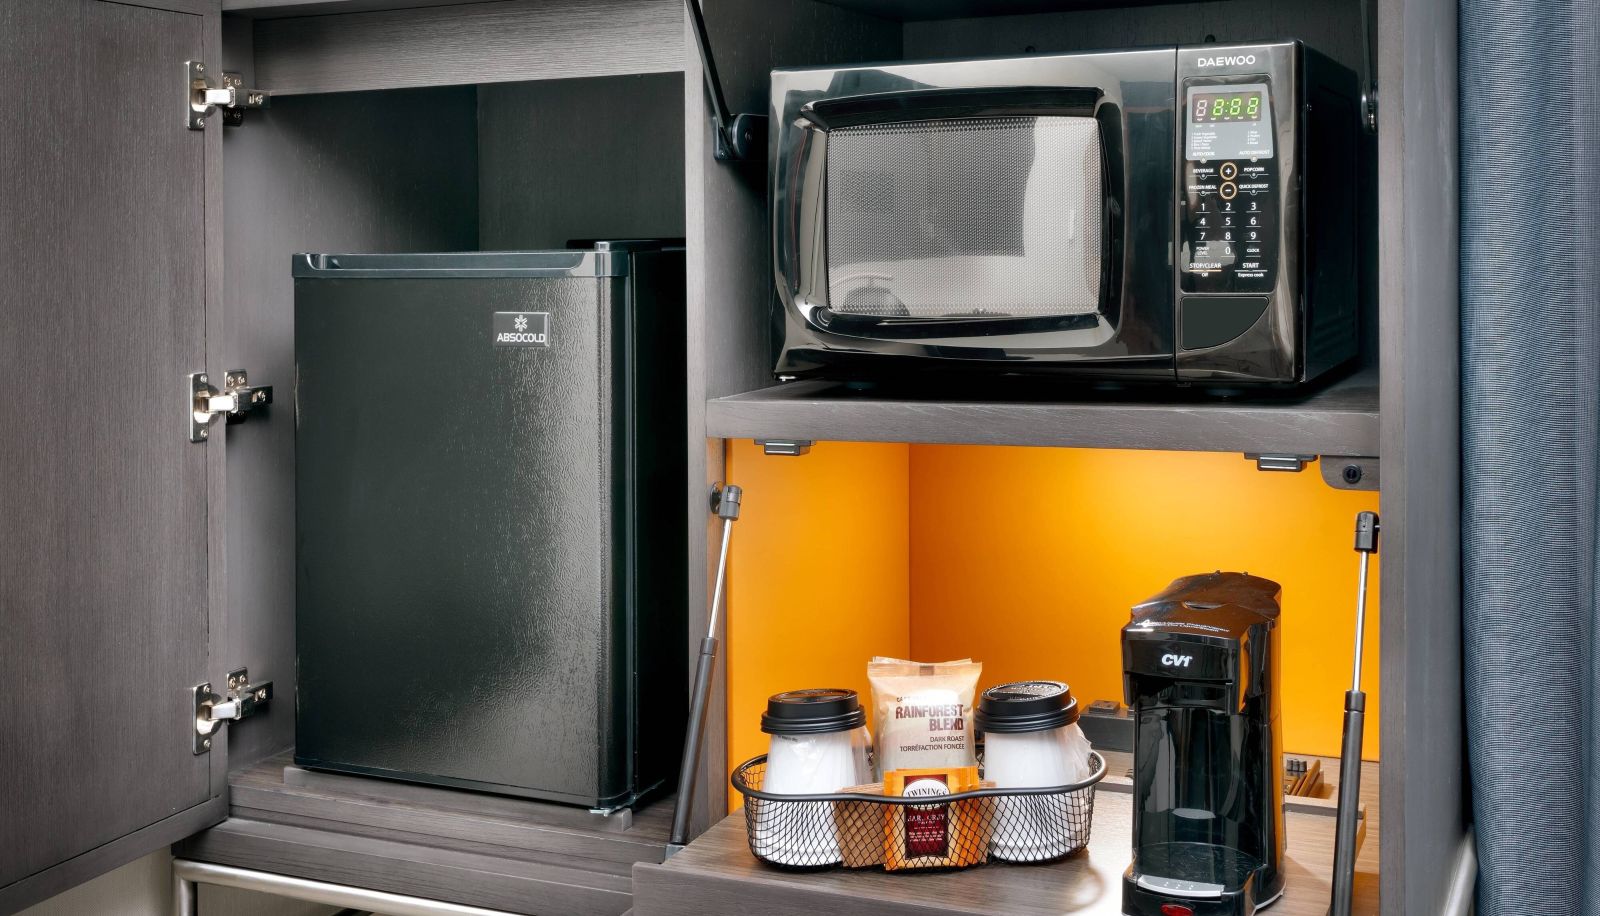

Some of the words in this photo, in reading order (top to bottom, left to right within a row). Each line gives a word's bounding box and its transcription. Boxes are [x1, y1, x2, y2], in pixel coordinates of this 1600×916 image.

[1197, 55, 1256, 67] DAEWOO
[1201, 203, 1205, 211] 1
[1225, 203, 1231, 211] 2
[1250, 202, 1257, 211] 3
[1225, 217, 1231, 225] 5
[1250, 217, 1257, 225] 6
[1200, 232, 1206, 240] 7
[1225, 232, 1231, 240] 8
[1250, 232, 1257, 240] 9
[496, 332, 546, 342] ABSOCOLD
[895, 704, 964, 719] RAINFOREST
[929, 718, 964, 731] BLEND
